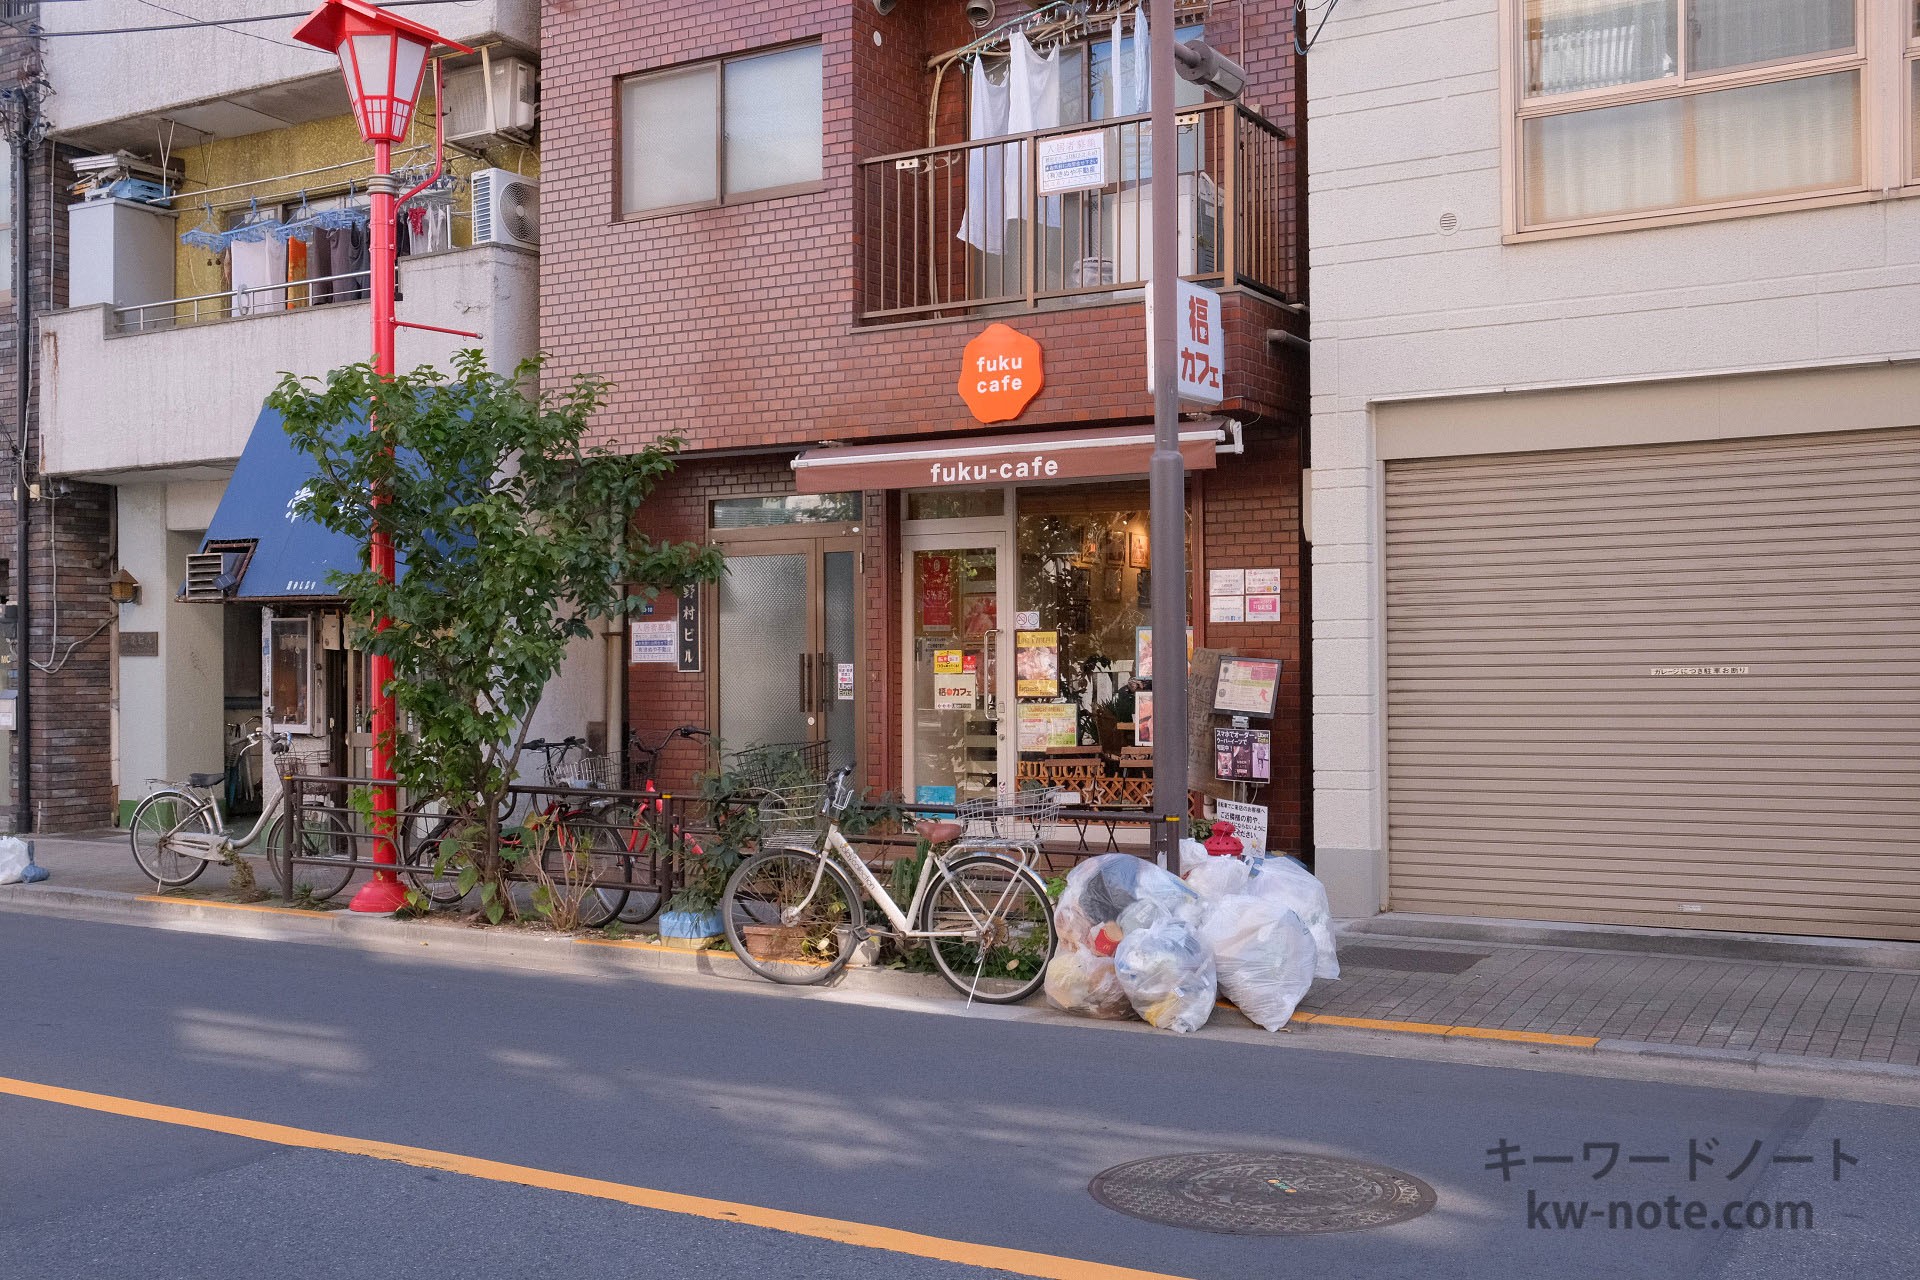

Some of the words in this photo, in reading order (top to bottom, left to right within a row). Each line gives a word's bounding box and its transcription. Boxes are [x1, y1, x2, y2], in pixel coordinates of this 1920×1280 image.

[1189, 295, 1209, 345] 福
[976, 355, 1022, 372] fuku
[1181, 347, 1220, 388] カフェ
[976, 375, 1022, 393] cafe
[930, 456, 1058, 482] fuku-cafe
[683, 584, 695, 663] 野村ビル
